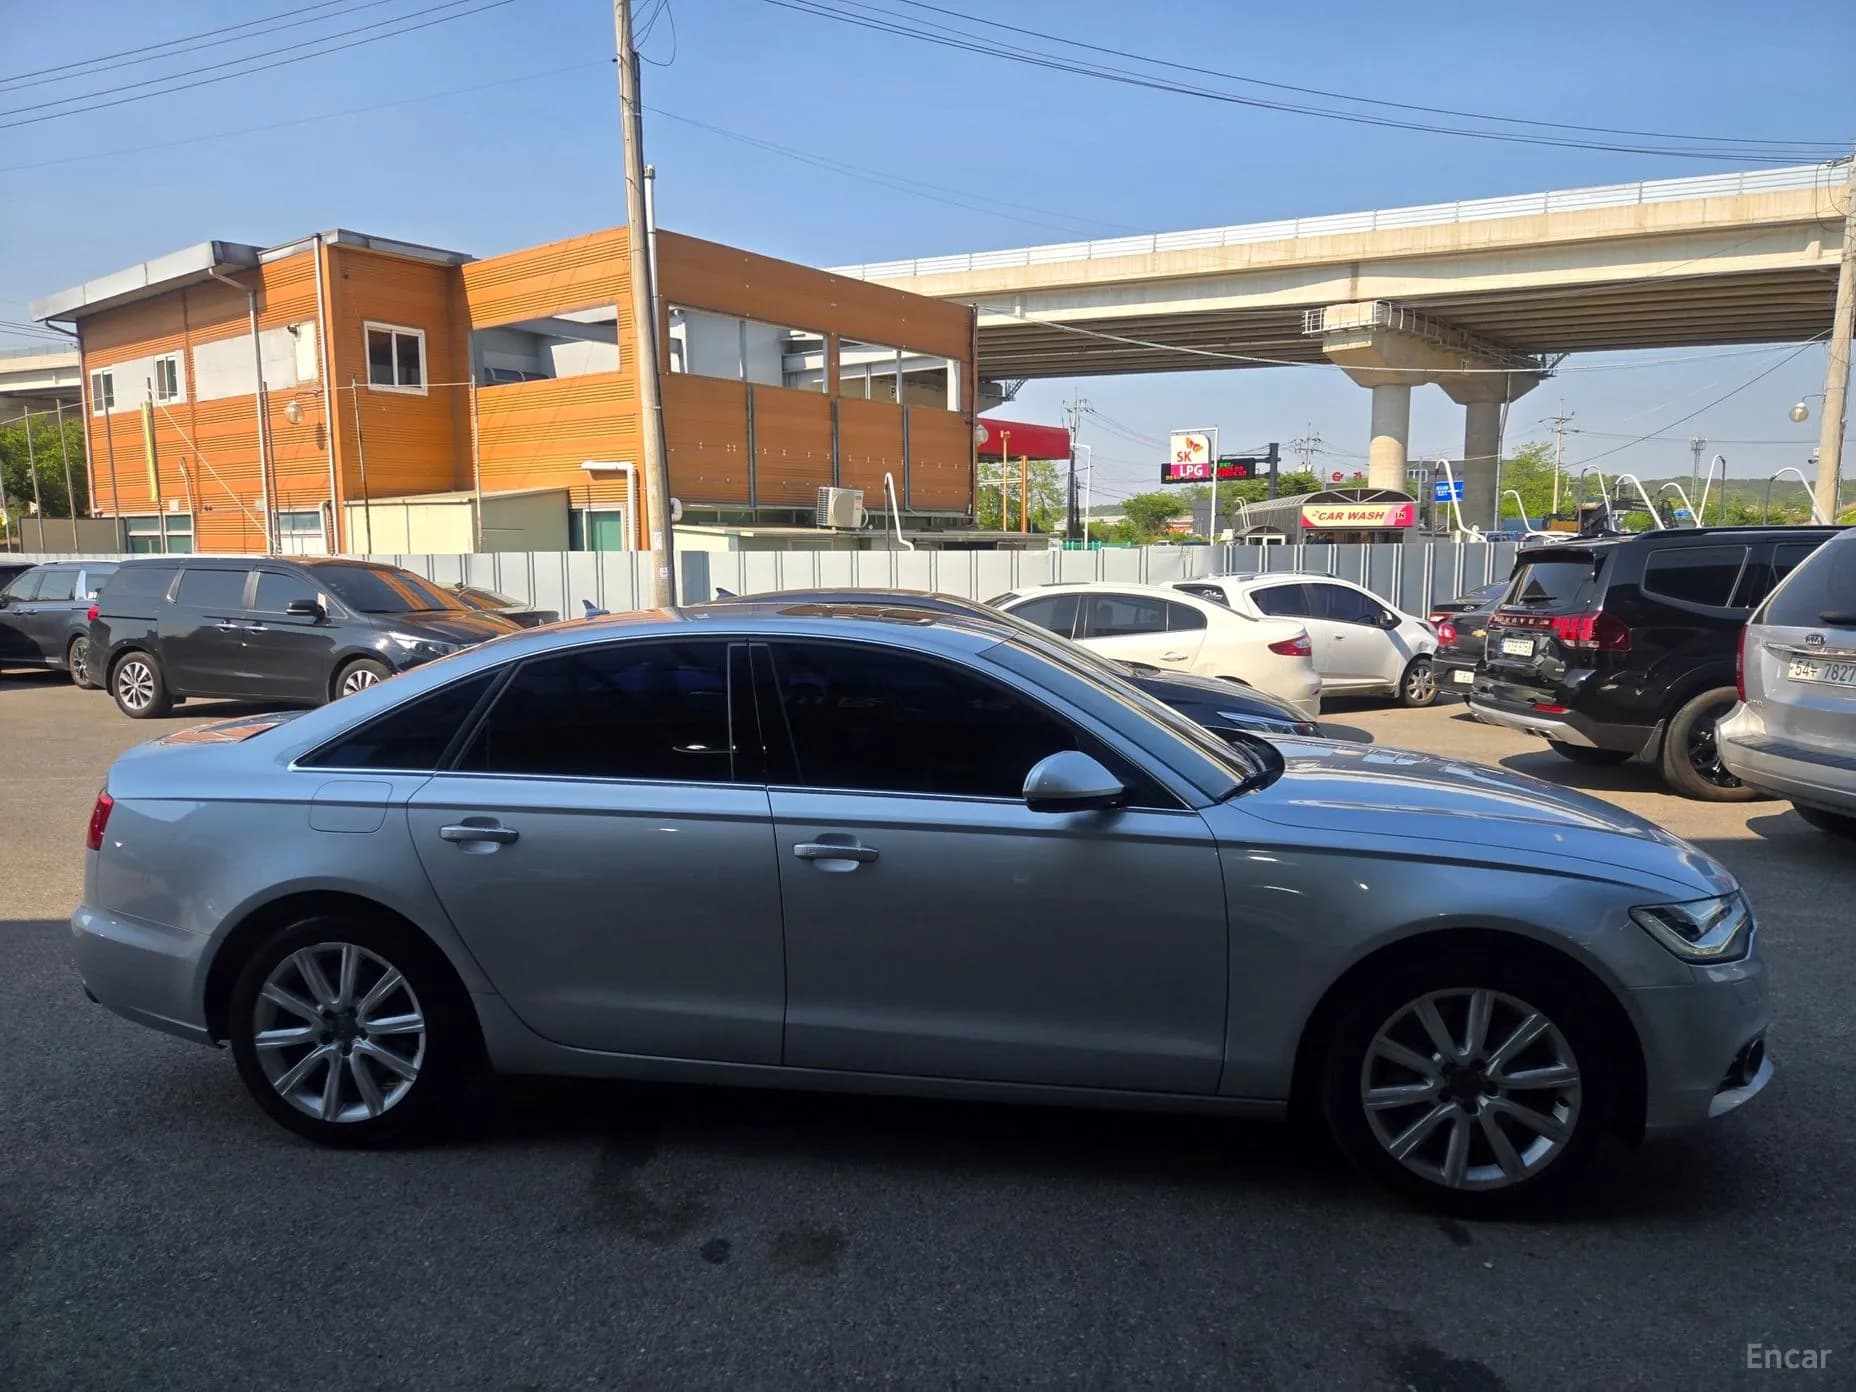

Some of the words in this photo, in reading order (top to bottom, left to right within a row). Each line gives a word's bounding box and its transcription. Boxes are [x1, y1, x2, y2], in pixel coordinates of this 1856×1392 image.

[1176, 451, 1191, 463] SK
[1179, 464, 1203, 477] LPG
[1318, 511, 1344, 521] CAR
[1347, 511, 1385, 520] WASH
[1823, 663, 1856, 683] 7827
